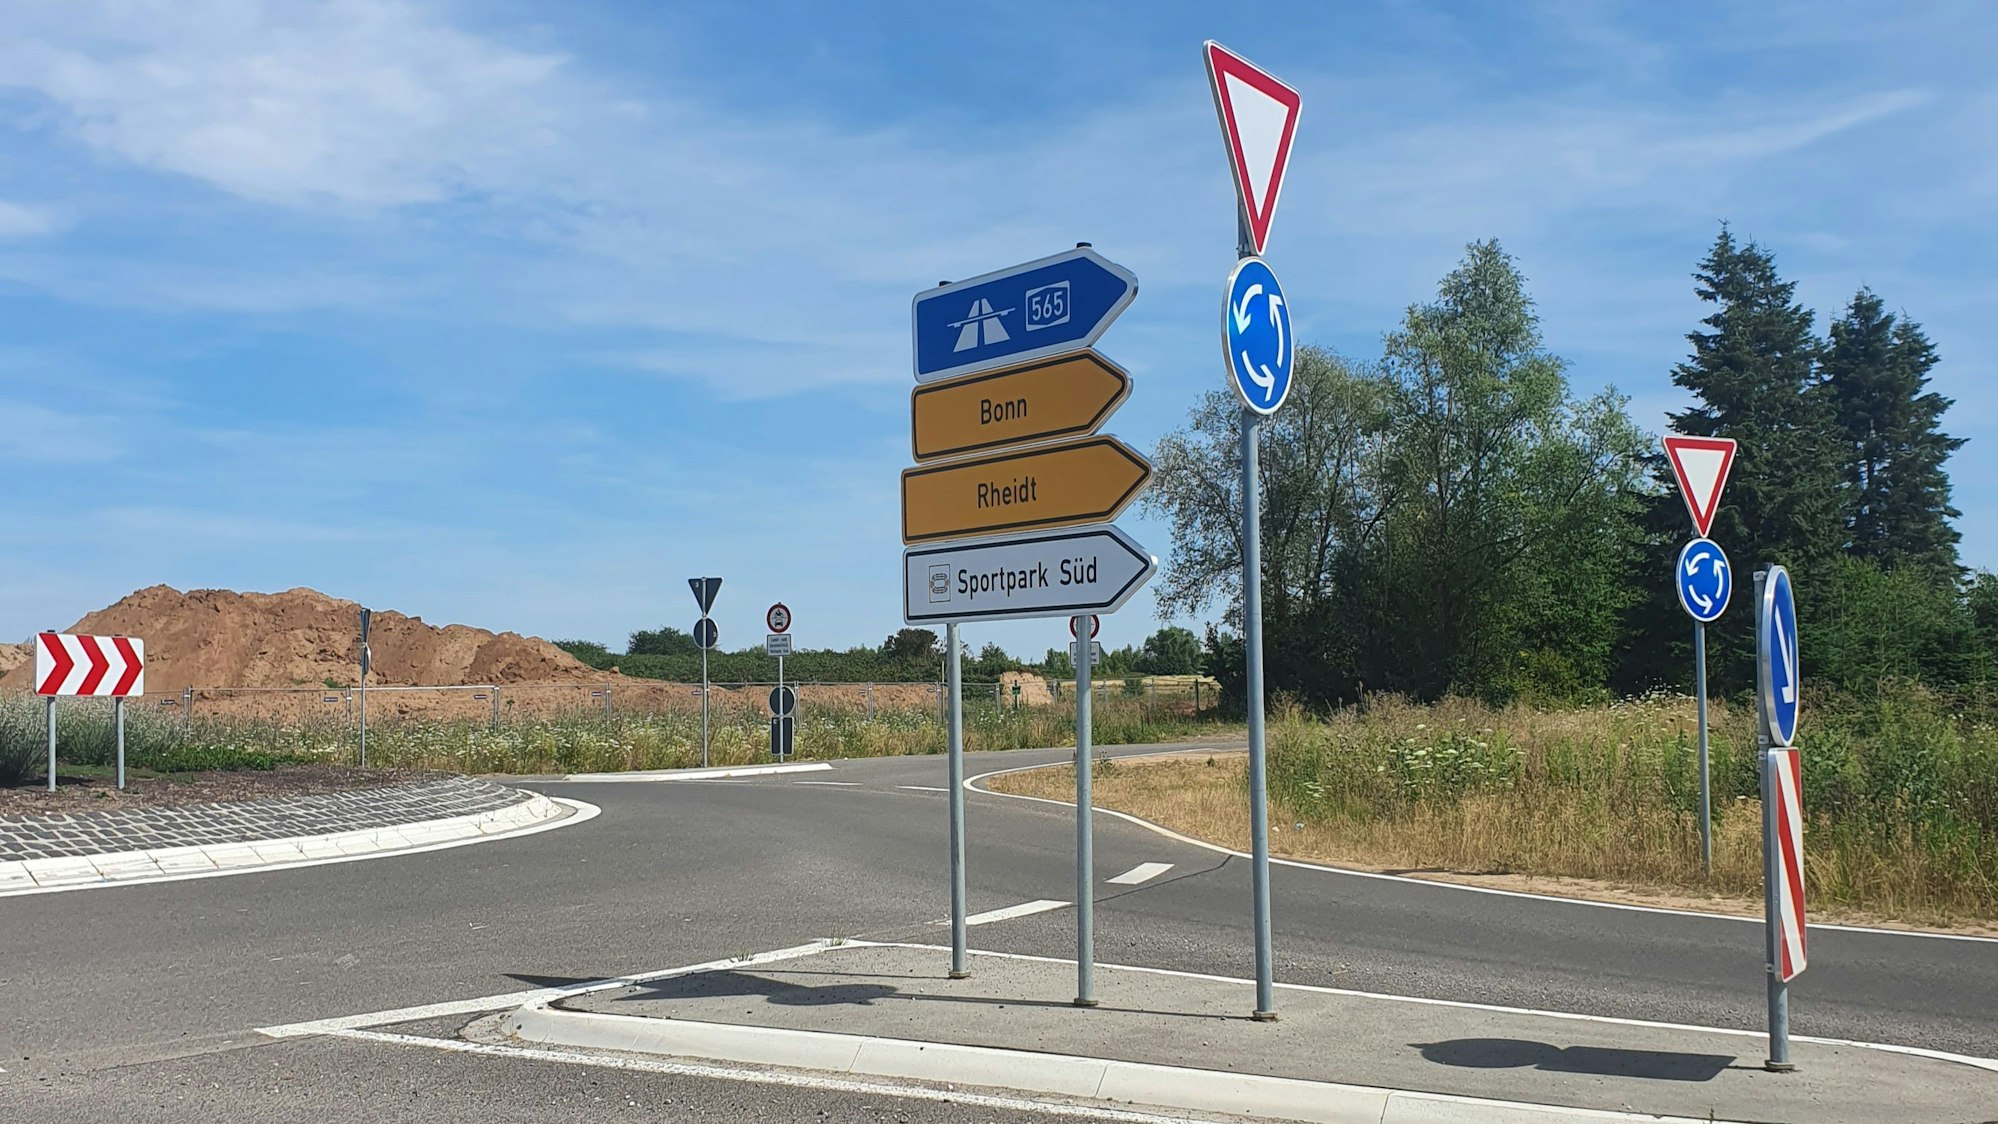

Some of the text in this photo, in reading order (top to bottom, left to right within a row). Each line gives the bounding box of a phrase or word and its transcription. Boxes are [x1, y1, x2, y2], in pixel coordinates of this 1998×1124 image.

[1032, 291, 1063, 321] 565
[980, 398, 1027, 425] Bonn
[977, 476, 1037, 508] Rheidt
[957, 556, 1097, 600] Sportpark Süd
